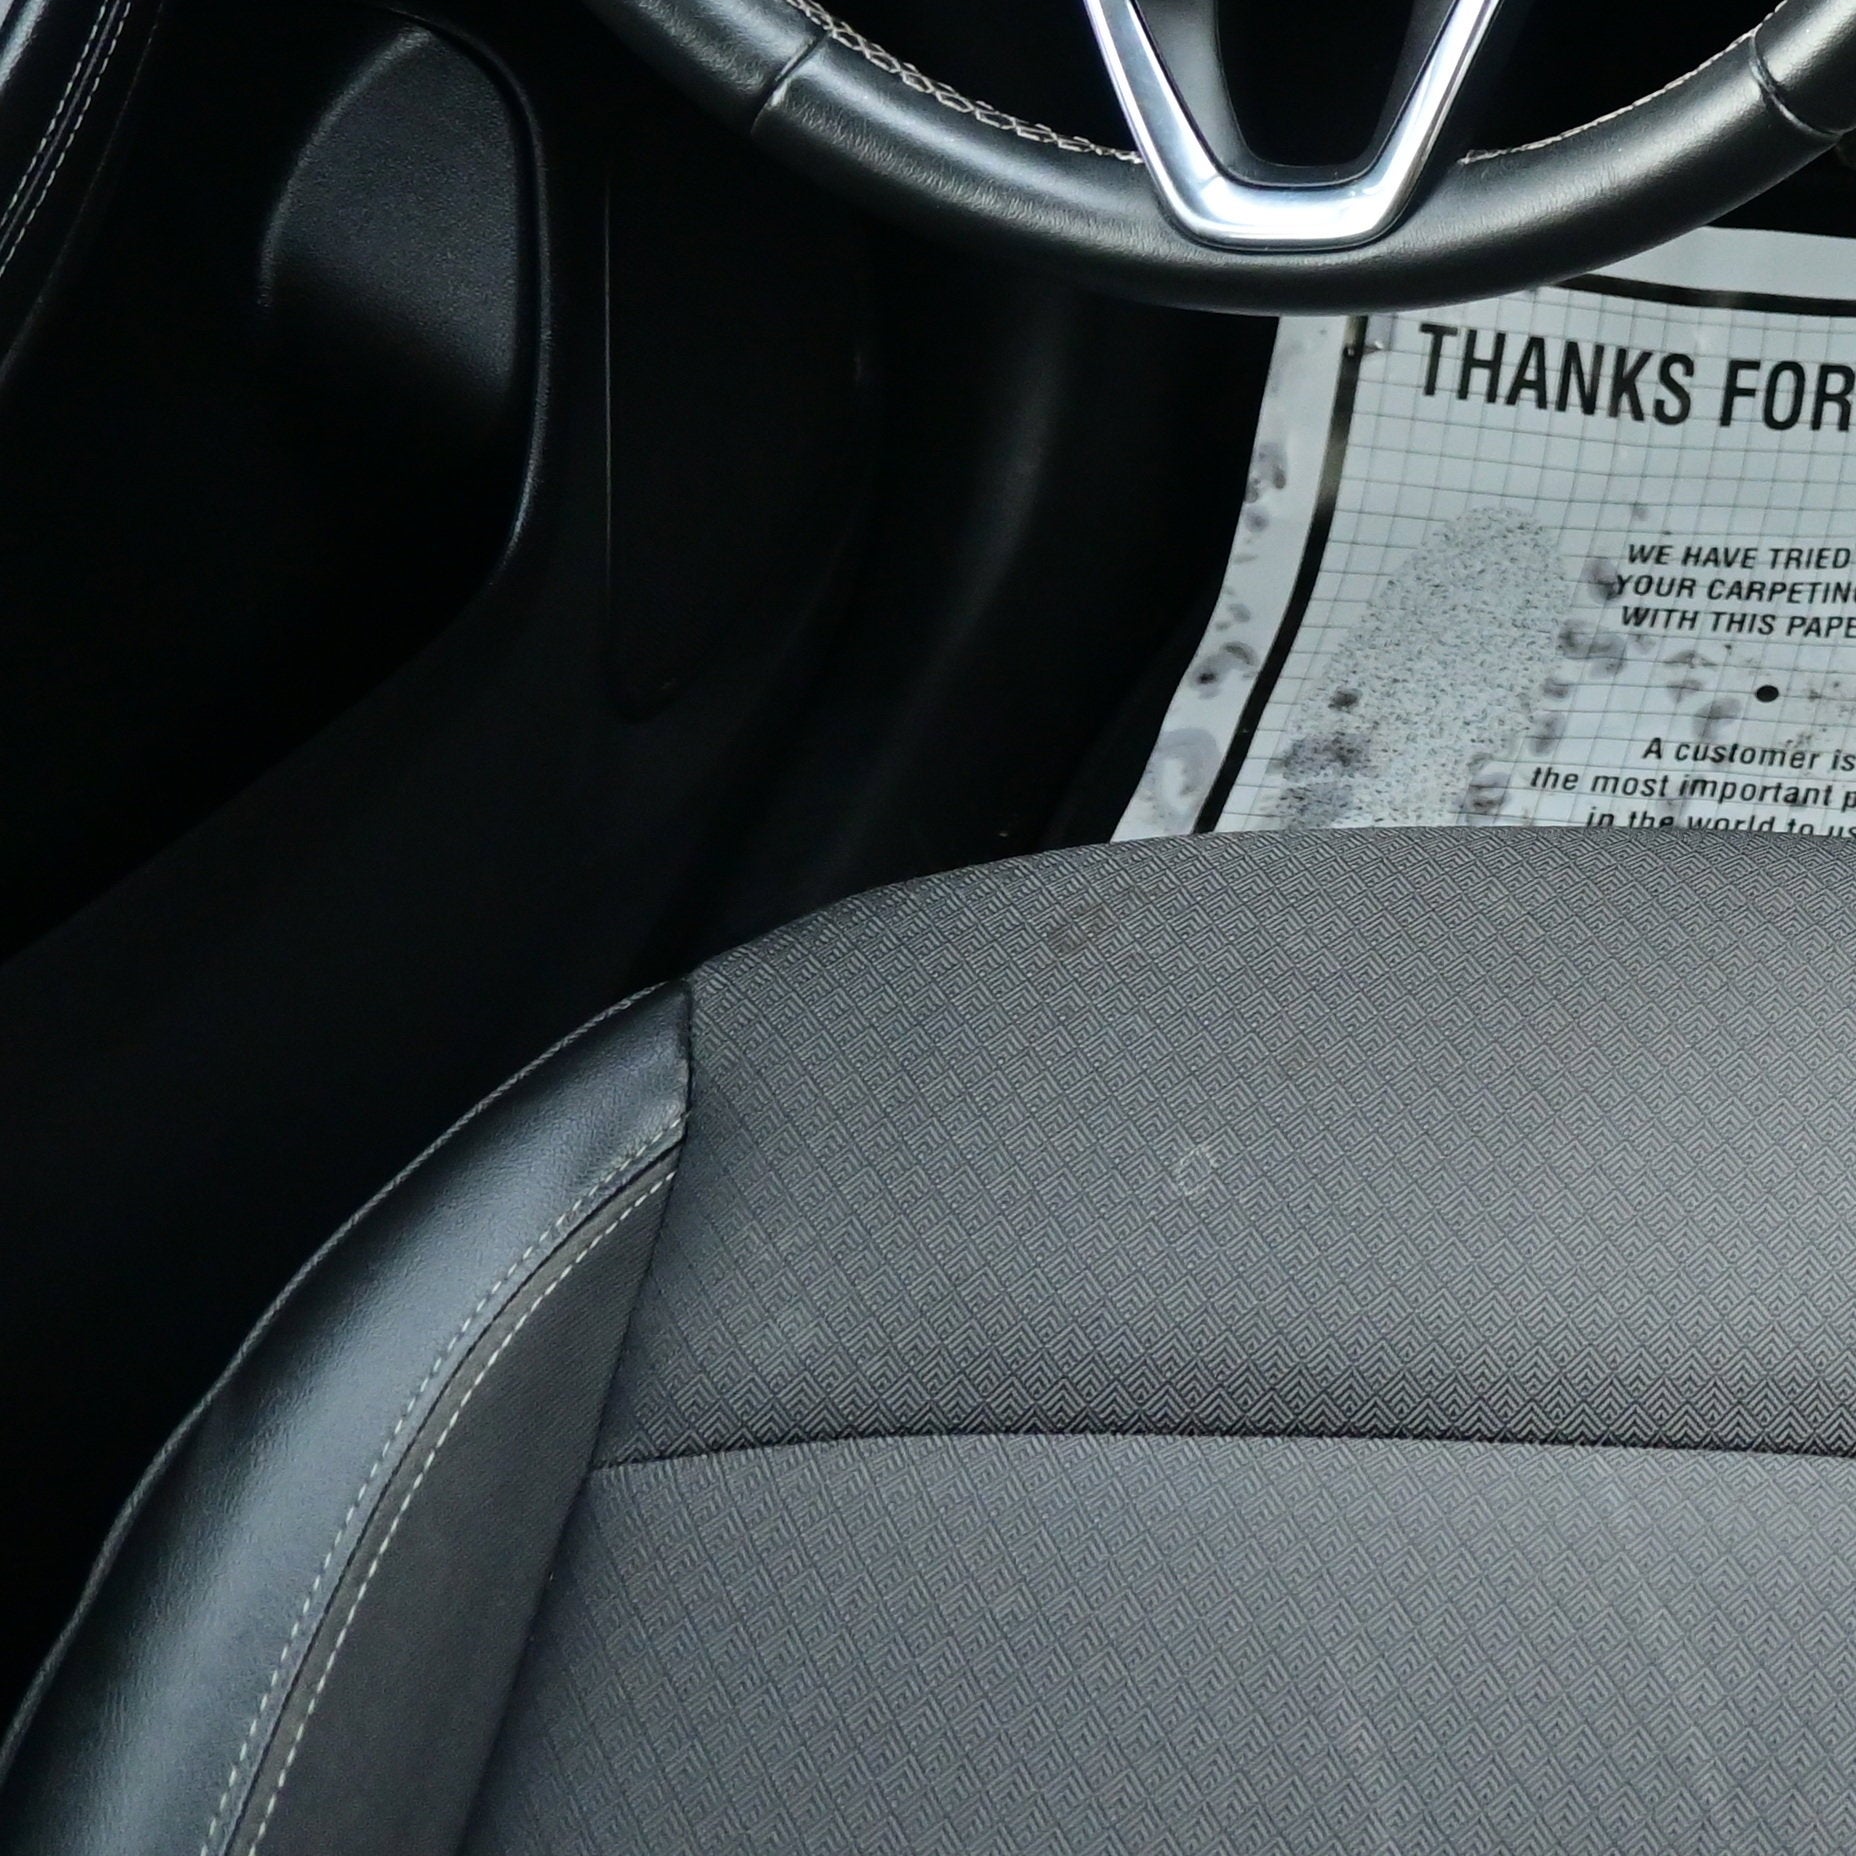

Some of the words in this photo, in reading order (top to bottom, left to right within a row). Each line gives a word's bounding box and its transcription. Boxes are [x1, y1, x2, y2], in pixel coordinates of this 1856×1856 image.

[1419, 324, 1695, 425] THANKS
[1719, 359, 1854, 432] FOR
[1628, 544, 1675, 566] WE
[1682, 546, 1758, 569] HAVE
[1768, 548, 1851, 570] TRIED
[1614, 575, 1696, 600] YOUR
[1621, 606, 1699, 631] WITH
[1710, 610, 1775, 635] THIS
[1642, 738, 1664, 760] A
[1674, 740, 1821, 771] customer
[1832, 749, 1856, 771] is
[1530, 766, 1579, 791] the
[1590, 772, 1667, 797] most
[1678, 772, 1831, 813] important
[1585, 806, 1614, 827] in
[1628, 811, 1675, 829] the
[1688, 812, 1776, 832] world
[1787, 817, 1814, 834] to
